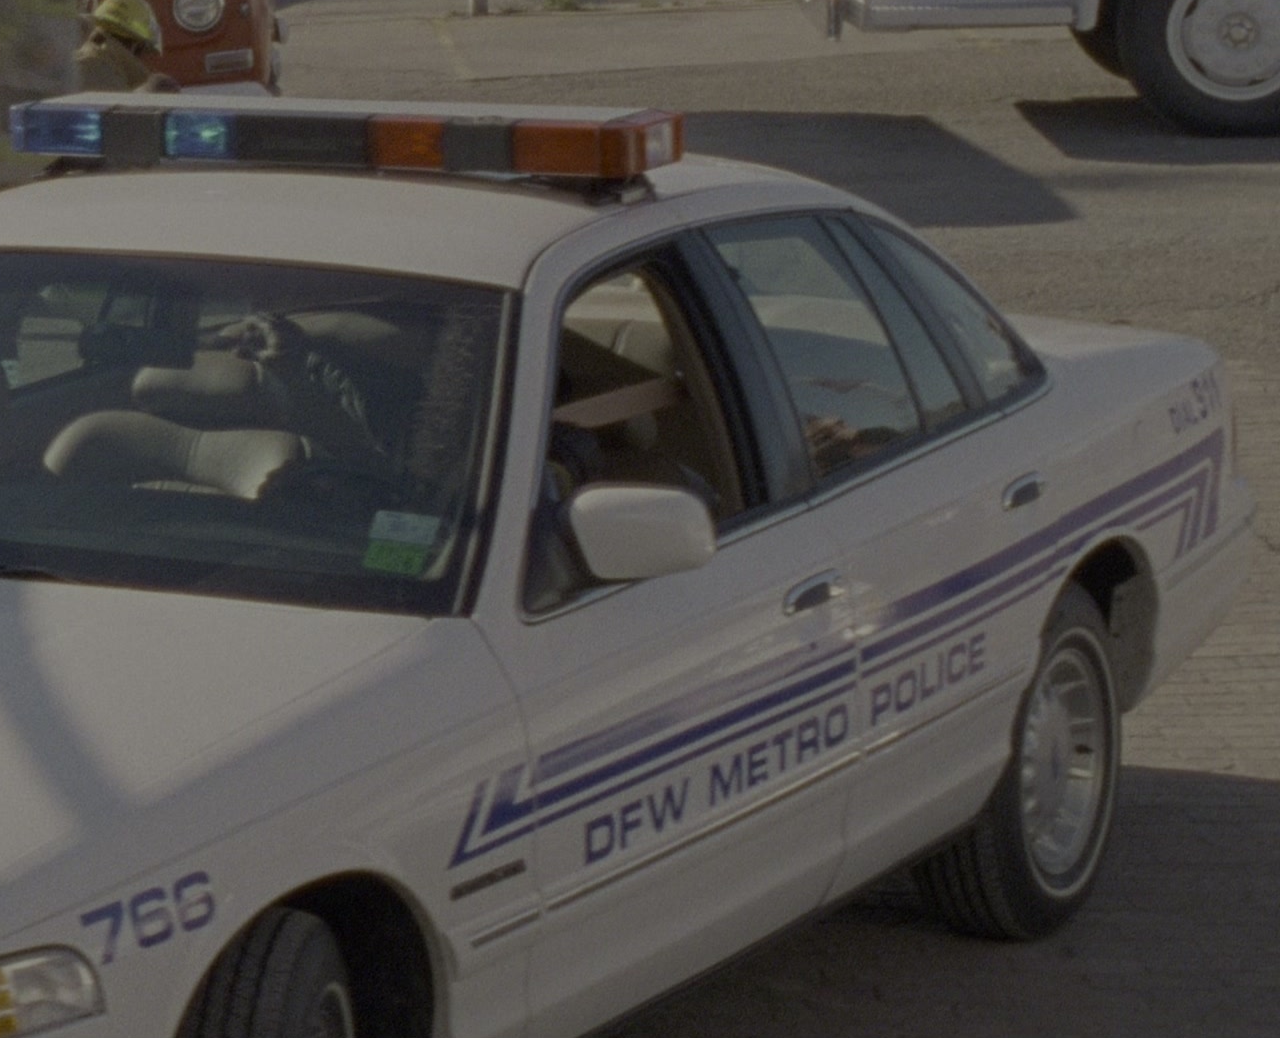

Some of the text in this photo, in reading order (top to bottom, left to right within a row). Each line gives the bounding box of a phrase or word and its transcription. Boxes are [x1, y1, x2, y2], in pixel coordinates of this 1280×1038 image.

[585, 634, 987, 864] DFW METRO POLICE
[80, 871, 215, 964] 766
